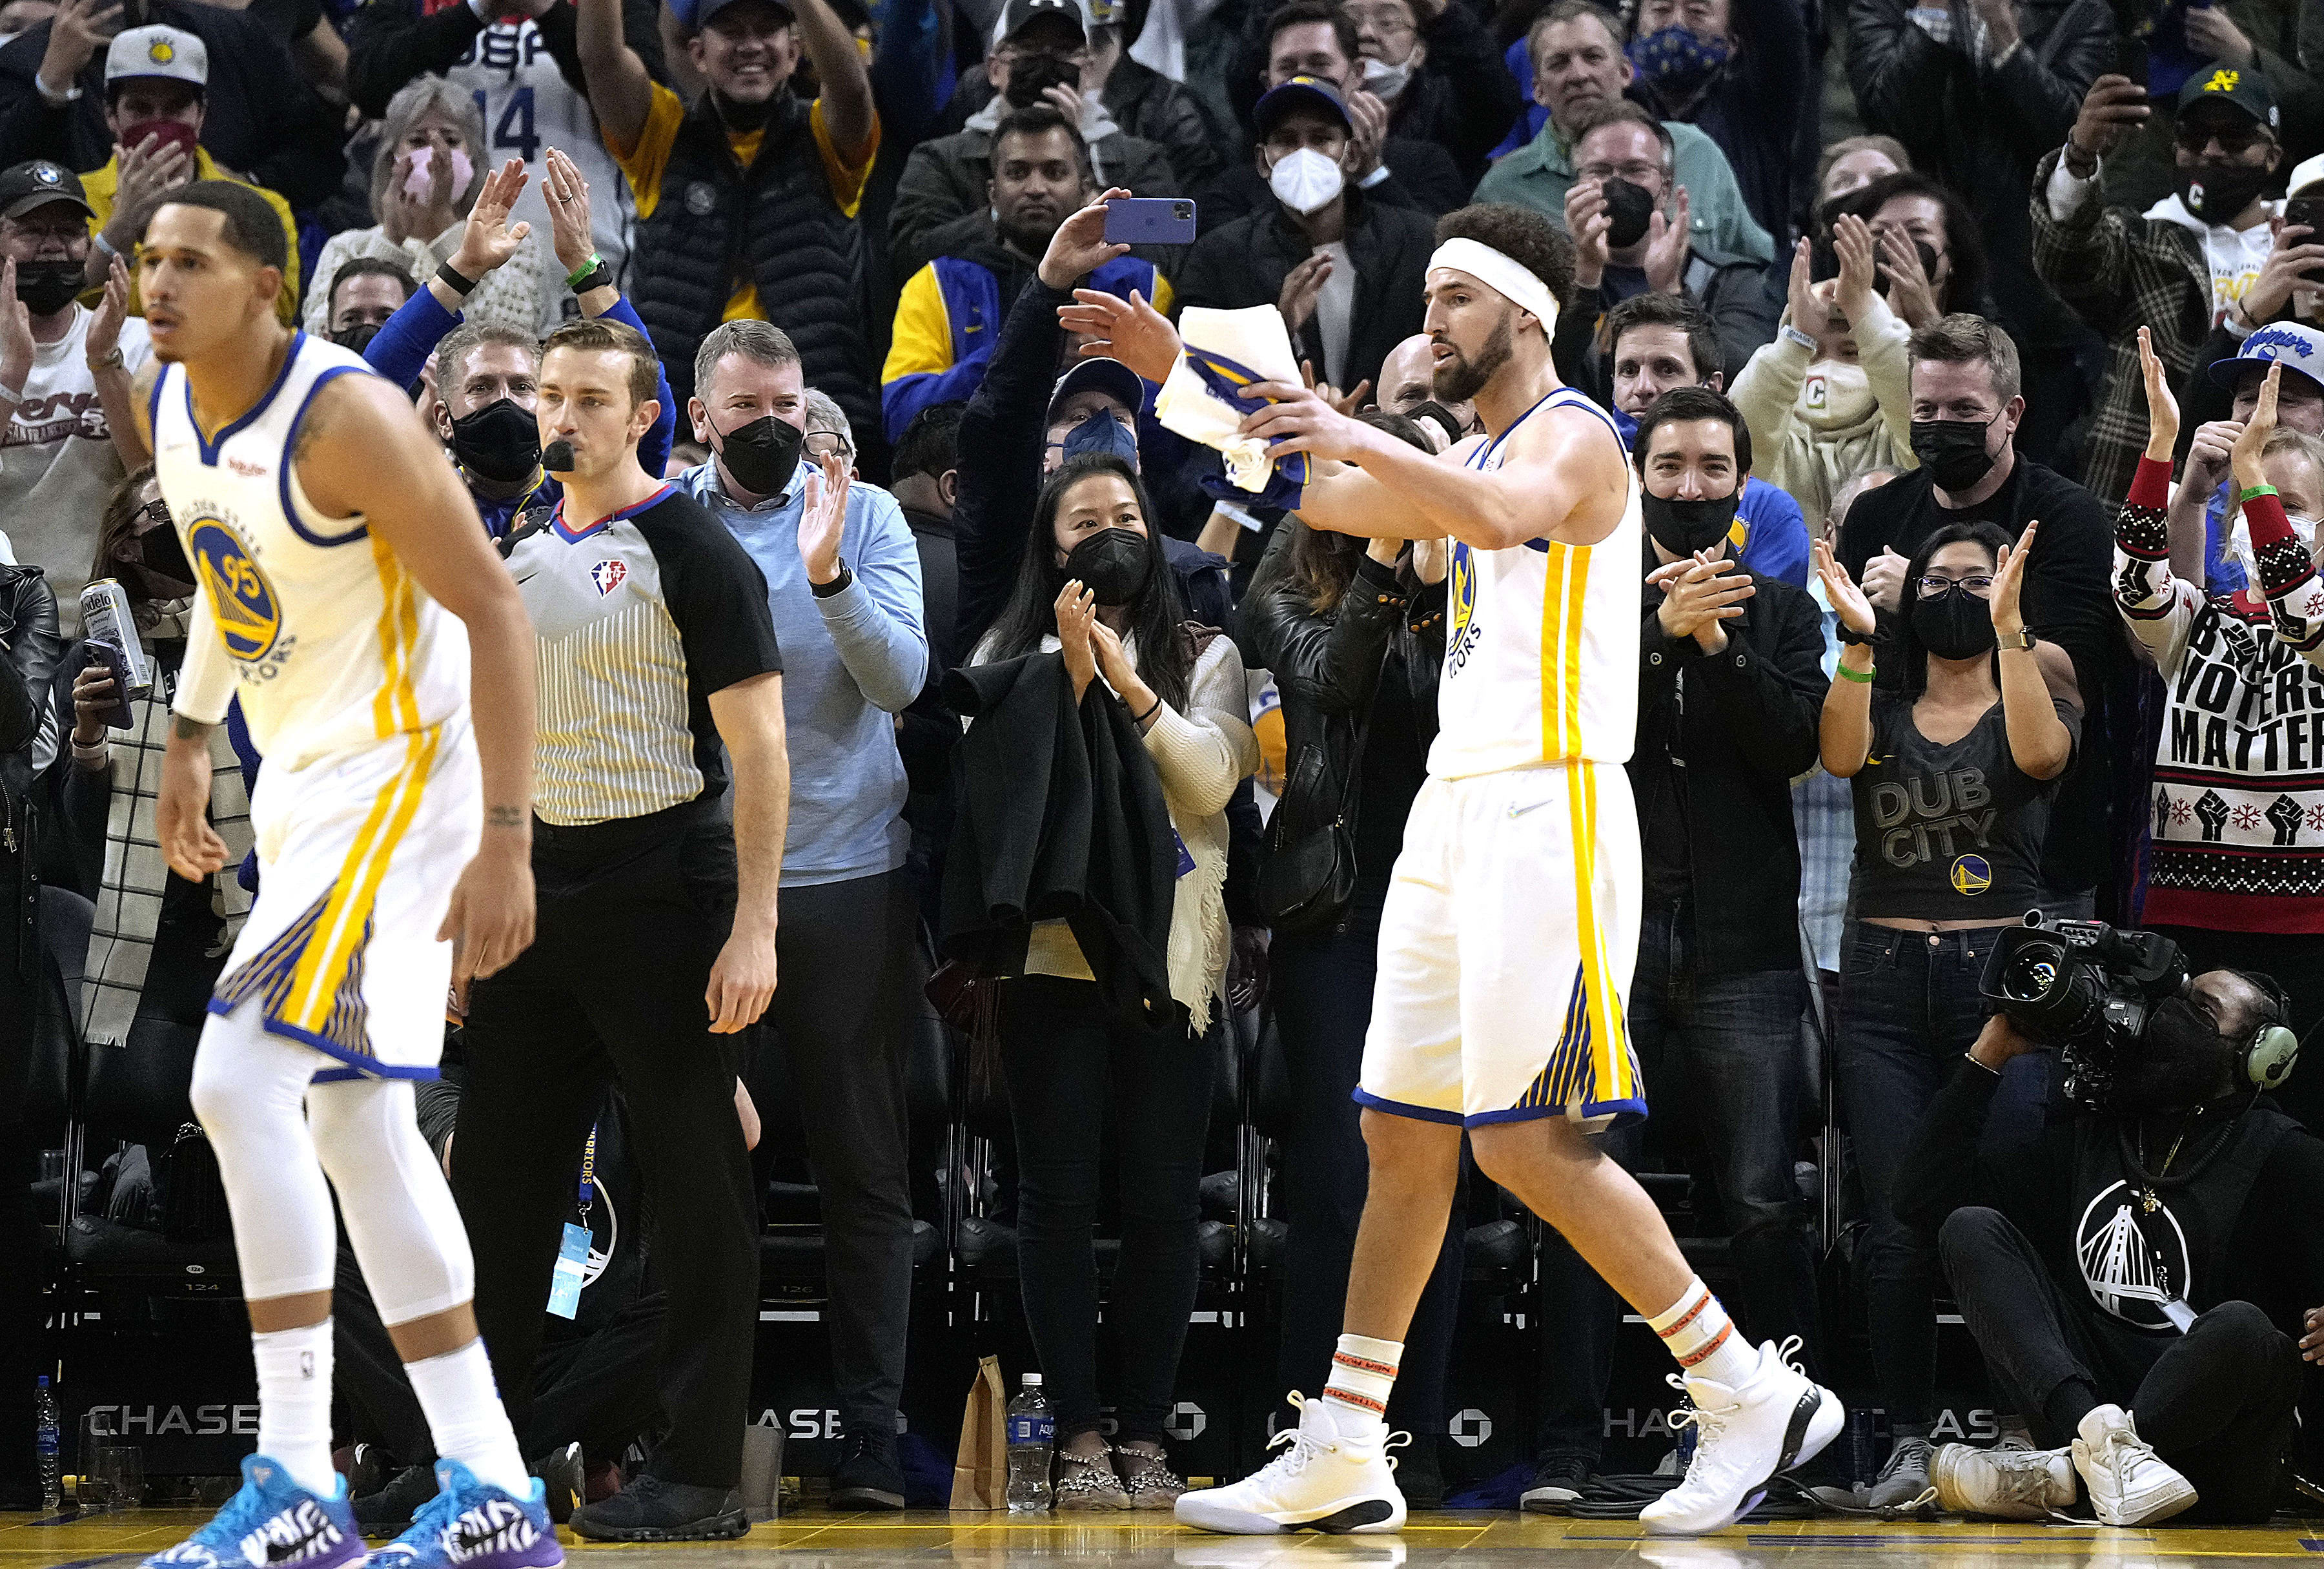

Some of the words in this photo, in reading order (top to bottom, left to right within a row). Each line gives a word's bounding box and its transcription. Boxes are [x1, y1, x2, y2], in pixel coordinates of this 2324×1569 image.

[222, 554, 261, 599] 95
[81, 593, 112, 613] odelo
[1871, 766, 1992, 829] DUB
[1882, 807, 1999, 868] CITY
[90, 1404, 261, 1435] CHASE
[745, 1408, 846, 1439] ASE
